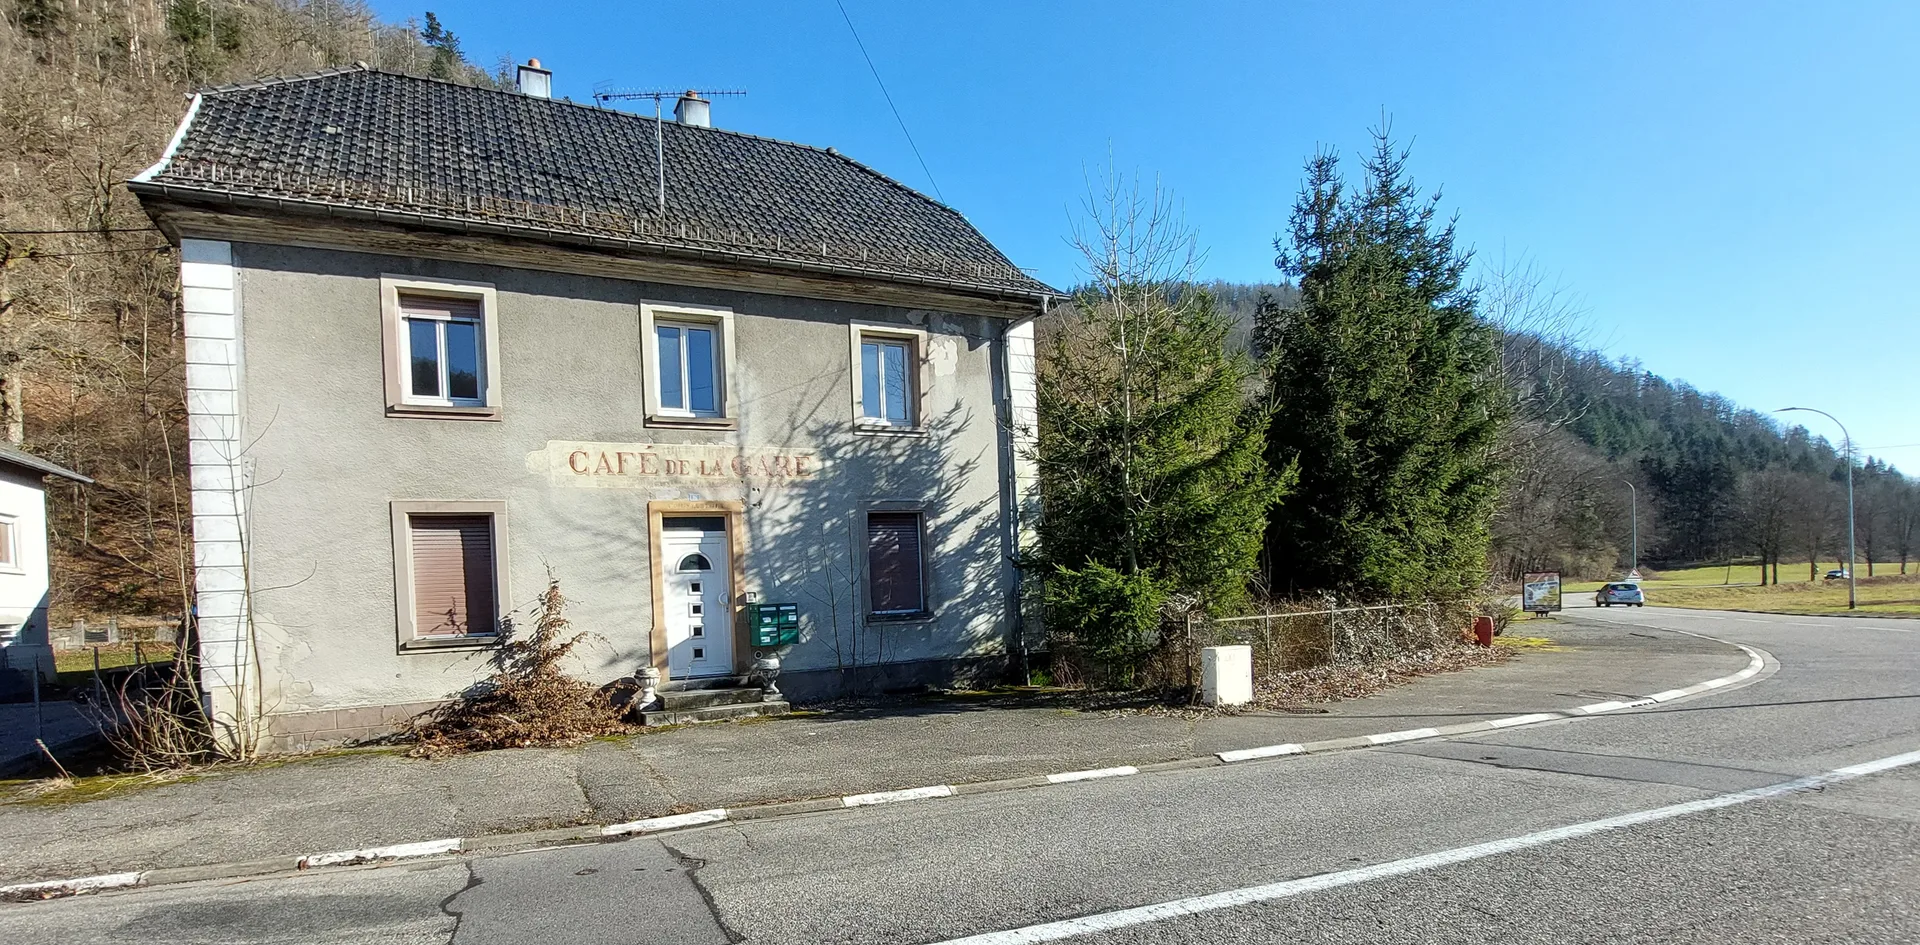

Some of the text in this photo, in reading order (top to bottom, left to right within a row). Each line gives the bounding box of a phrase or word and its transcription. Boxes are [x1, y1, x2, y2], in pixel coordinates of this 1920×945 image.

[568, 445, 660, 477] CAFÉ
[665, 459, 690, 475] DE
[699, 458, 725, 477] LA
[731, 455, 811, 478] GARE
